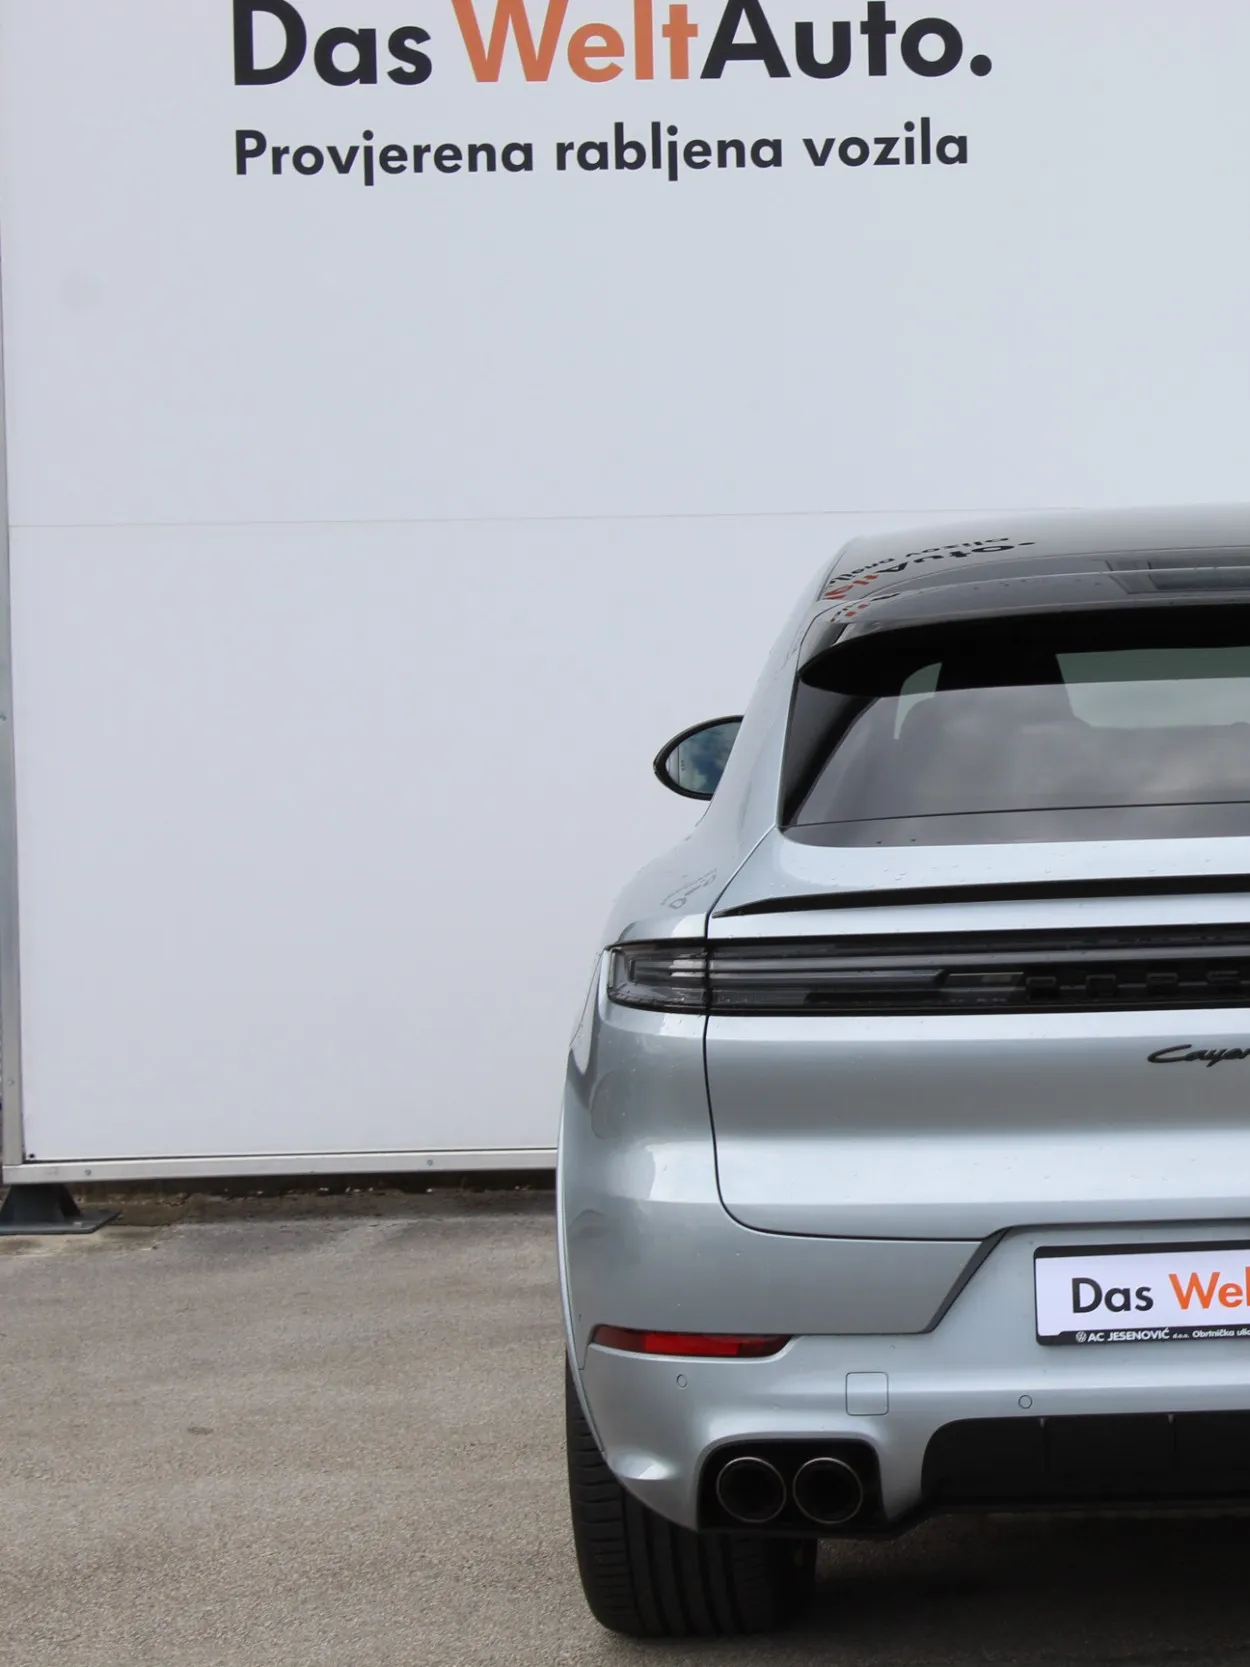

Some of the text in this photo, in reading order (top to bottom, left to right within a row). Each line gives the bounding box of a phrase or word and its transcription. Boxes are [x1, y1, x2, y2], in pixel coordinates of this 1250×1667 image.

[232, 0, 993, 87] Das WeltAuto.
[234, 116, 969, 187] Provjerena rabljena vozila
[1071, 1275, 1154, 1314] Das
[1088, 1332, 1105, 1343] AC
[1106, 1327, 1170, 1342] JESENOVIĆ
